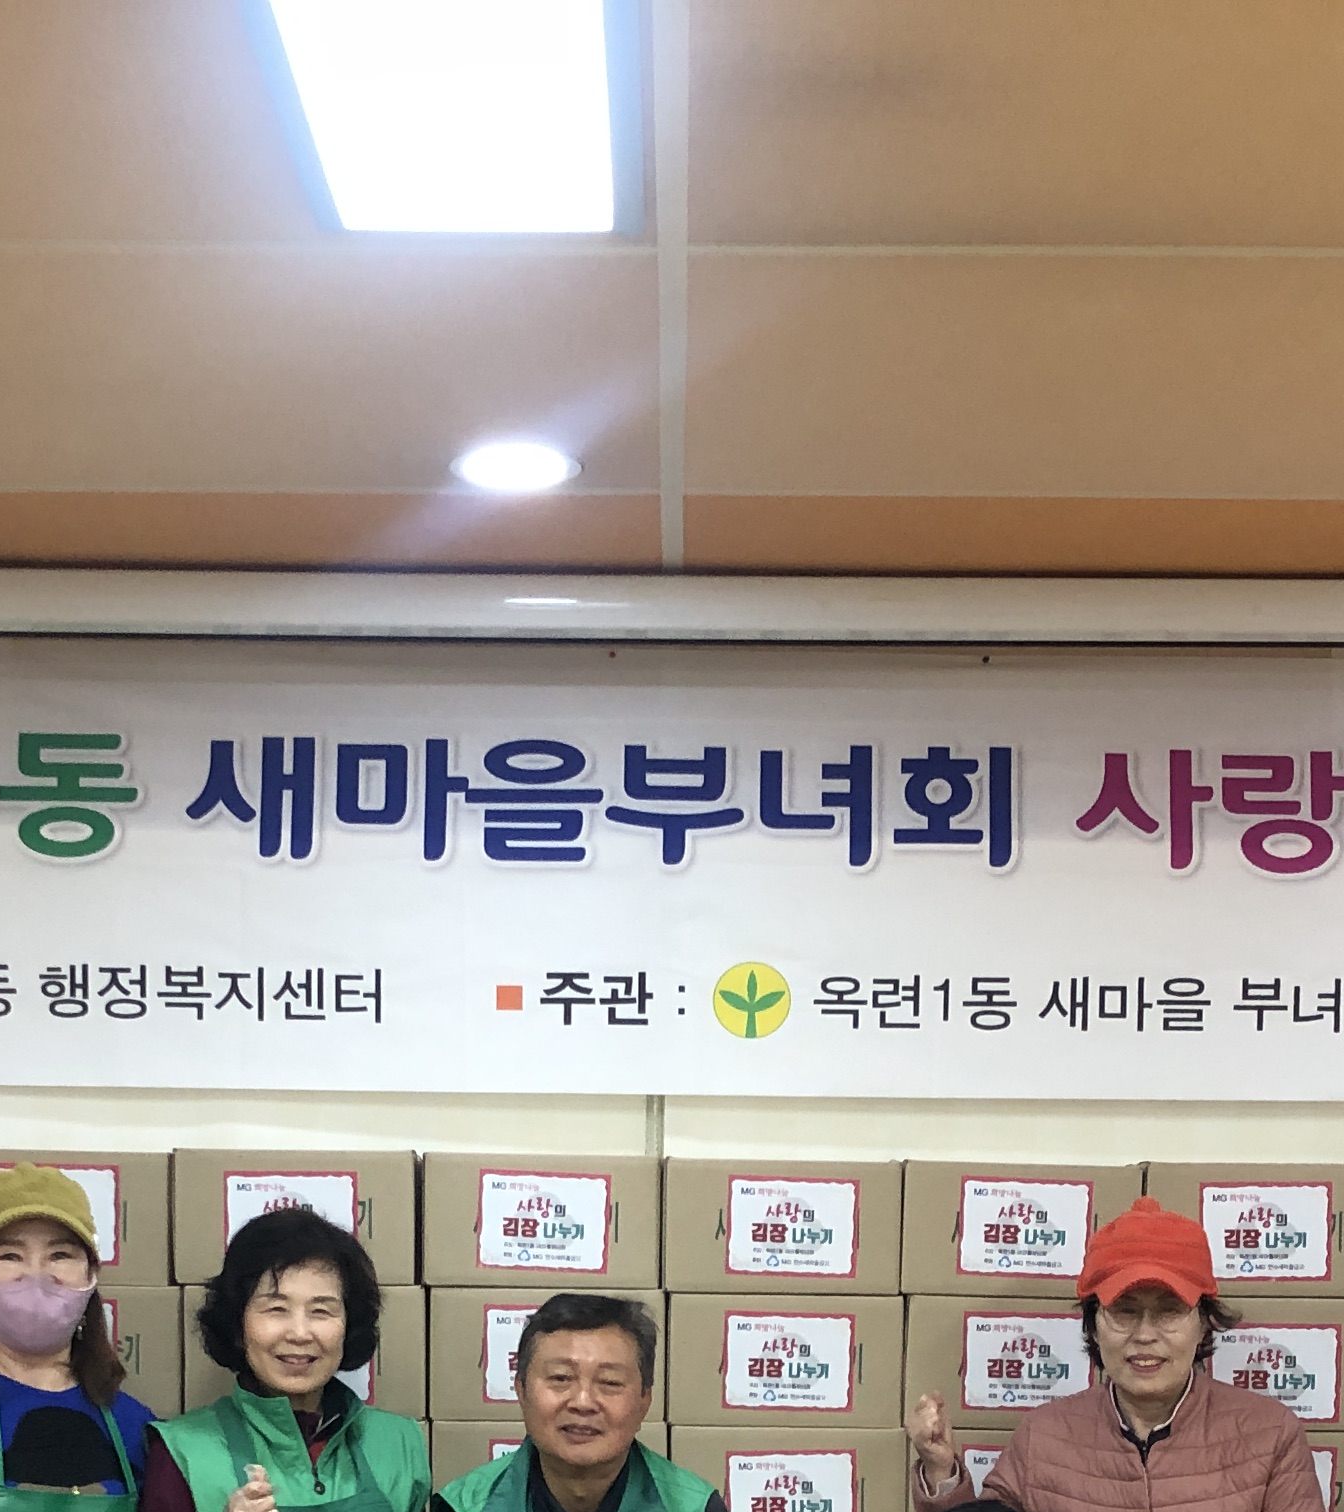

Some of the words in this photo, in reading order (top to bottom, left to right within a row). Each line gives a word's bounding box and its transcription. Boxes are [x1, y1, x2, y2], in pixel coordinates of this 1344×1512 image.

[187, 738, 1011, 866] 새마을부녀회
[39, 963, 382, 1023] 행정복지센터
[540, 971, 654, 1025] 주관
[813, 974, 1018, 1031] 옥련1동
[1038, 976, 1211, 1032] 새마을
[741, 1187, 756, 1196] MG
[974, 1188, 989, 1196] MG
[1213, 1194, 1227, 1202] MG
[517, 1197, 565, 1219] 사랑의
[765, 1202, 814, 1224] 사랑의
[998, 1203, 1047, 1225] 사랑의
[1238, 1207, 1286, 1229] 사랑의
[502, 1217, 540, 1238] 김장
[543, 1223, 584, 1239] 나누기
[751, 1223, 788, 1243] 김장
[792, 1228, 832, 1244] 나누기
[984, 1224, 1021, 1244] 김장
[1024, 1229, 1065, 1245] 나누기
[1225, 1228, 1262, 1249] 김장
[1266, 1232, 1306, 1248] 나누기
[496, 1317, 512, 1325] MG
[737, 1323, 752, 1331] MG
[976, 1324, 991, 1332] MG
[762, 1337, 810, 1359] 사랑의
[1001, 1338, 1050, 1359] 사랑의
[1222, 1335, 1237, 1343] MG
[748, 1358, 785, 1378] 김장
[788, 1362, 829, 1379] 나누기
[987, 1358, 1024, 1379] 김장
[1028, 1363, 1069, 1379] 나누기
[1247, 1349, 1296, 1370] 사랑의
[1233, 1369, 1270, 1390] 김장
[1274, 1373, 1315, 1389] 나누기
[738, 1463, 753, 1471] MG
[973, 1456, 989, 1465] MG
[764, 1475, 812, 1496] 사랑의
